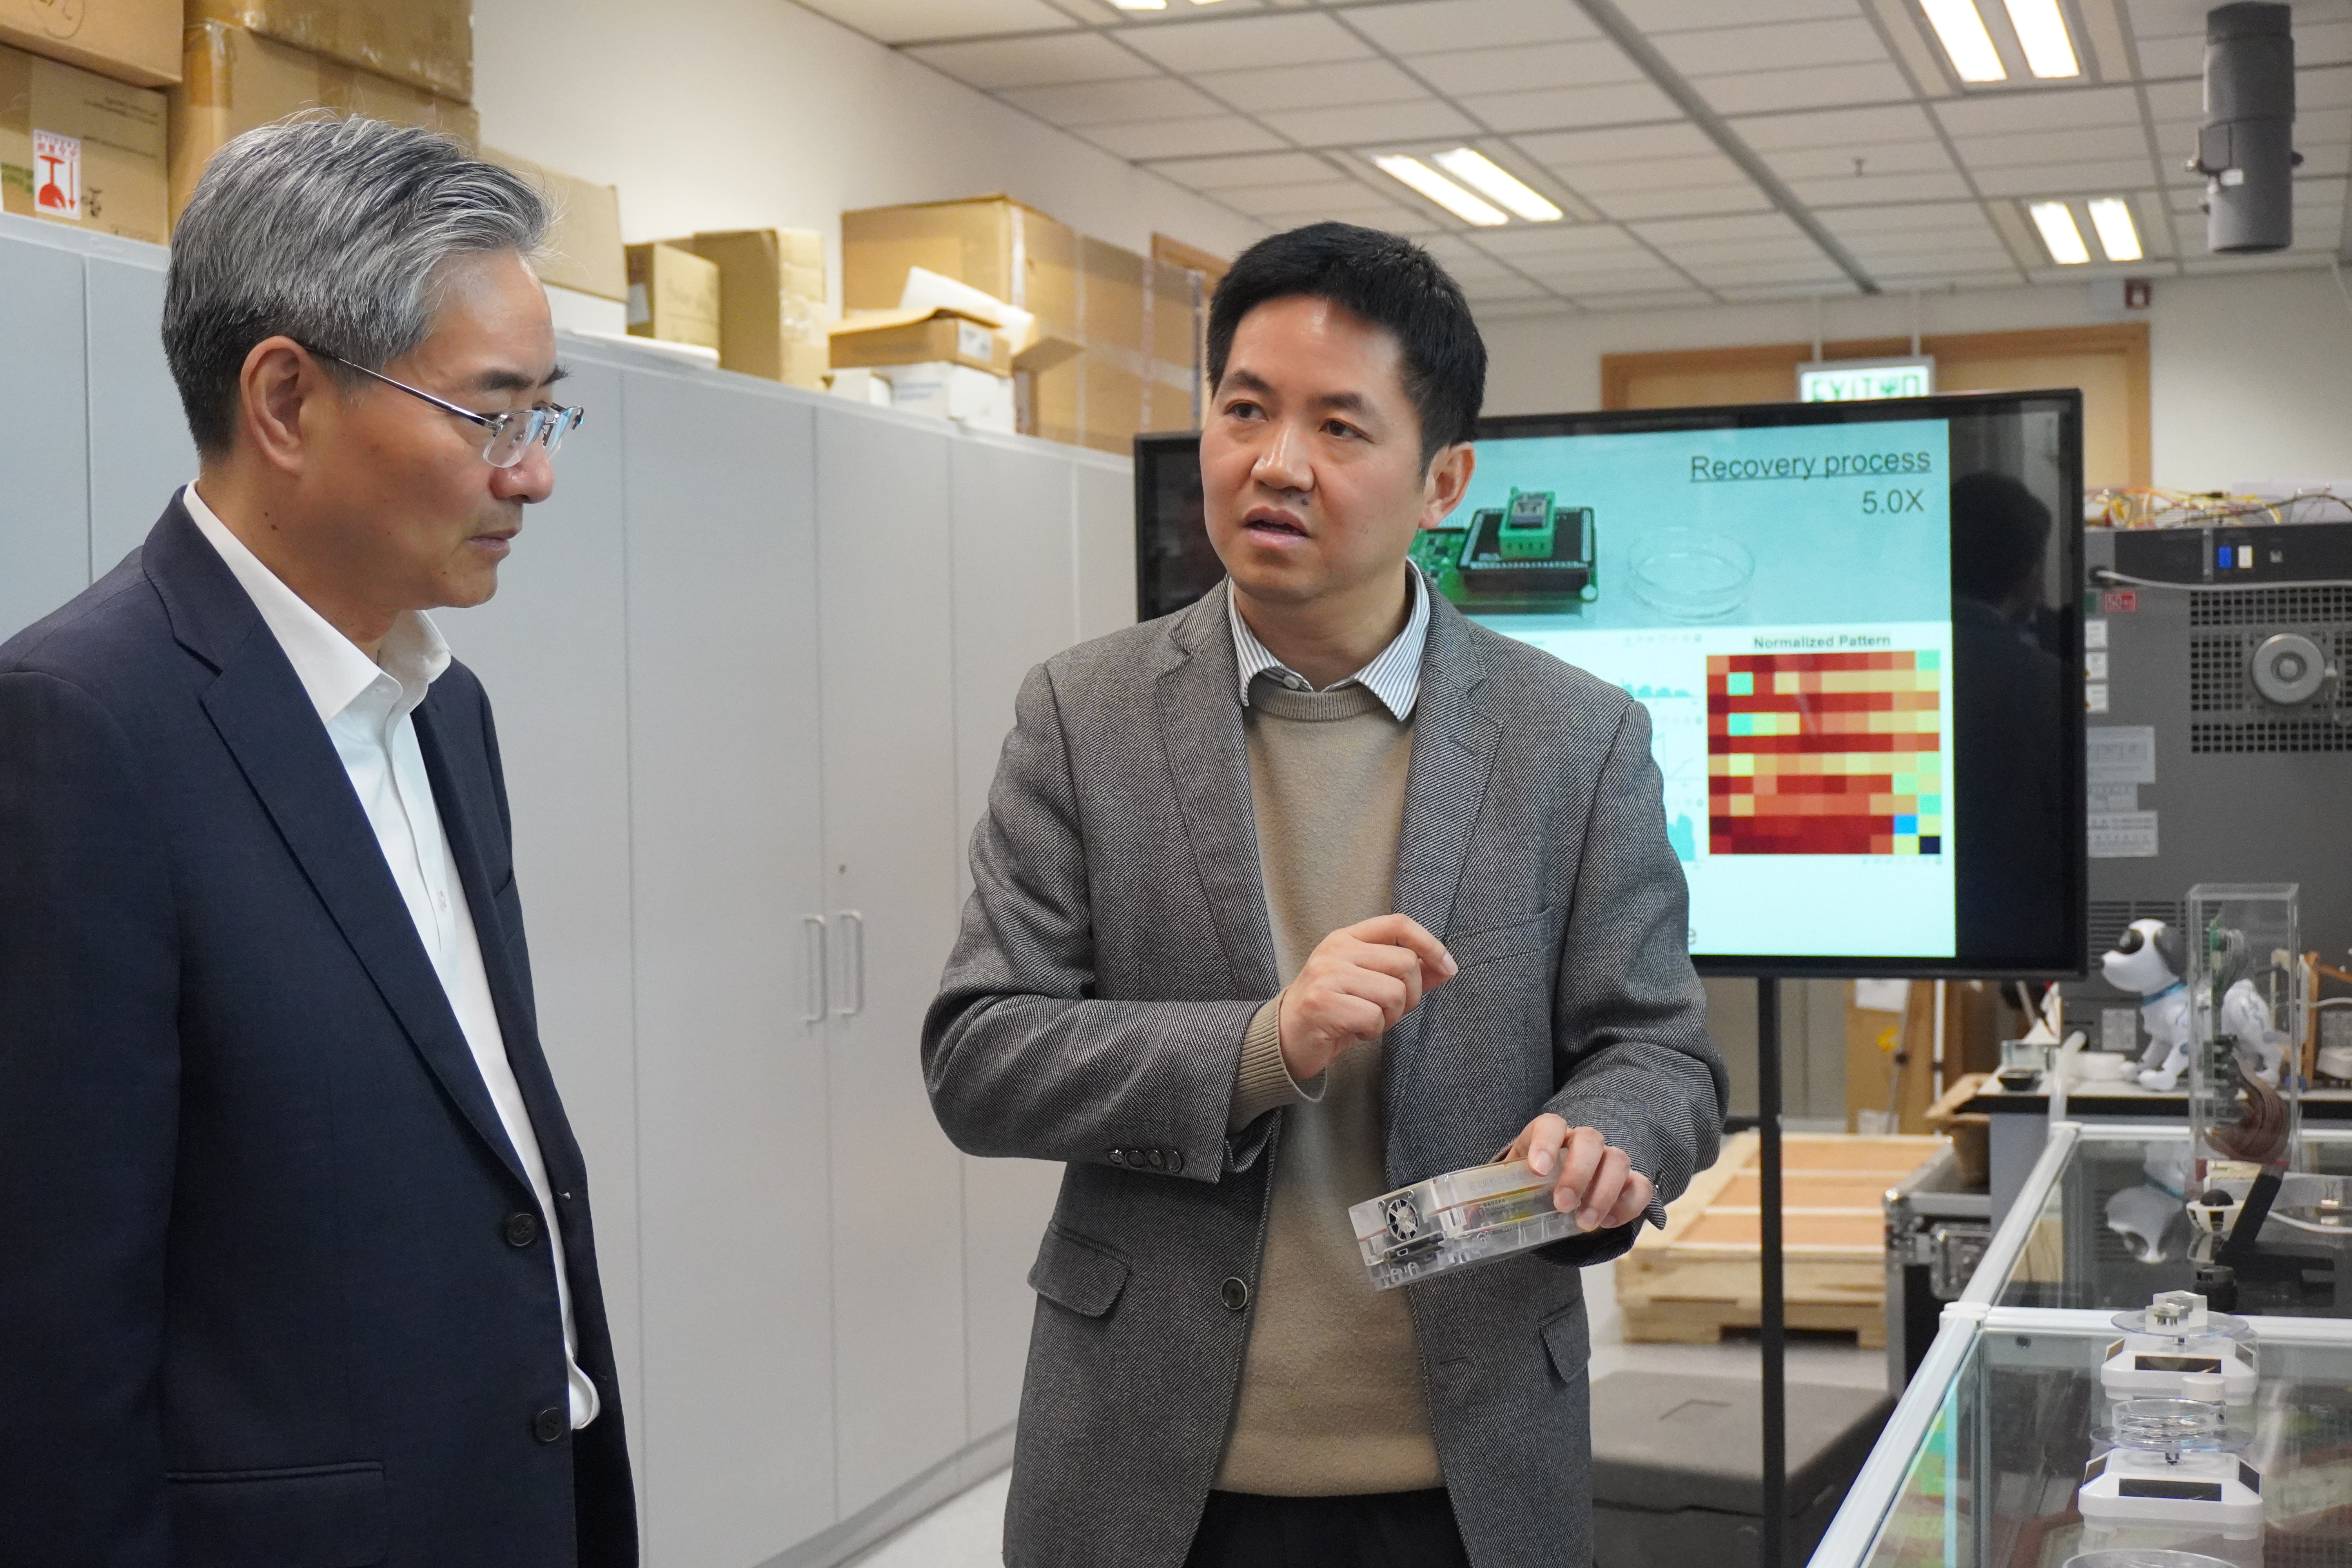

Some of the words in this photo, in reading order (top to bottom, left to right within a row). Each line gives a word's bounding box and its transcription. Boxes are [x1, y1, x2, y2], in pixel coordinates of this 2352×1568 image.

[1691, 455, 1816, 481] Recovery
[1824, 450, 1931, 479] process
[1862, 488, 1925, 514] 5.0X
[1754, 636, 1834, 649] Normalized
[1839, 634, 1891, 647] Pattern
